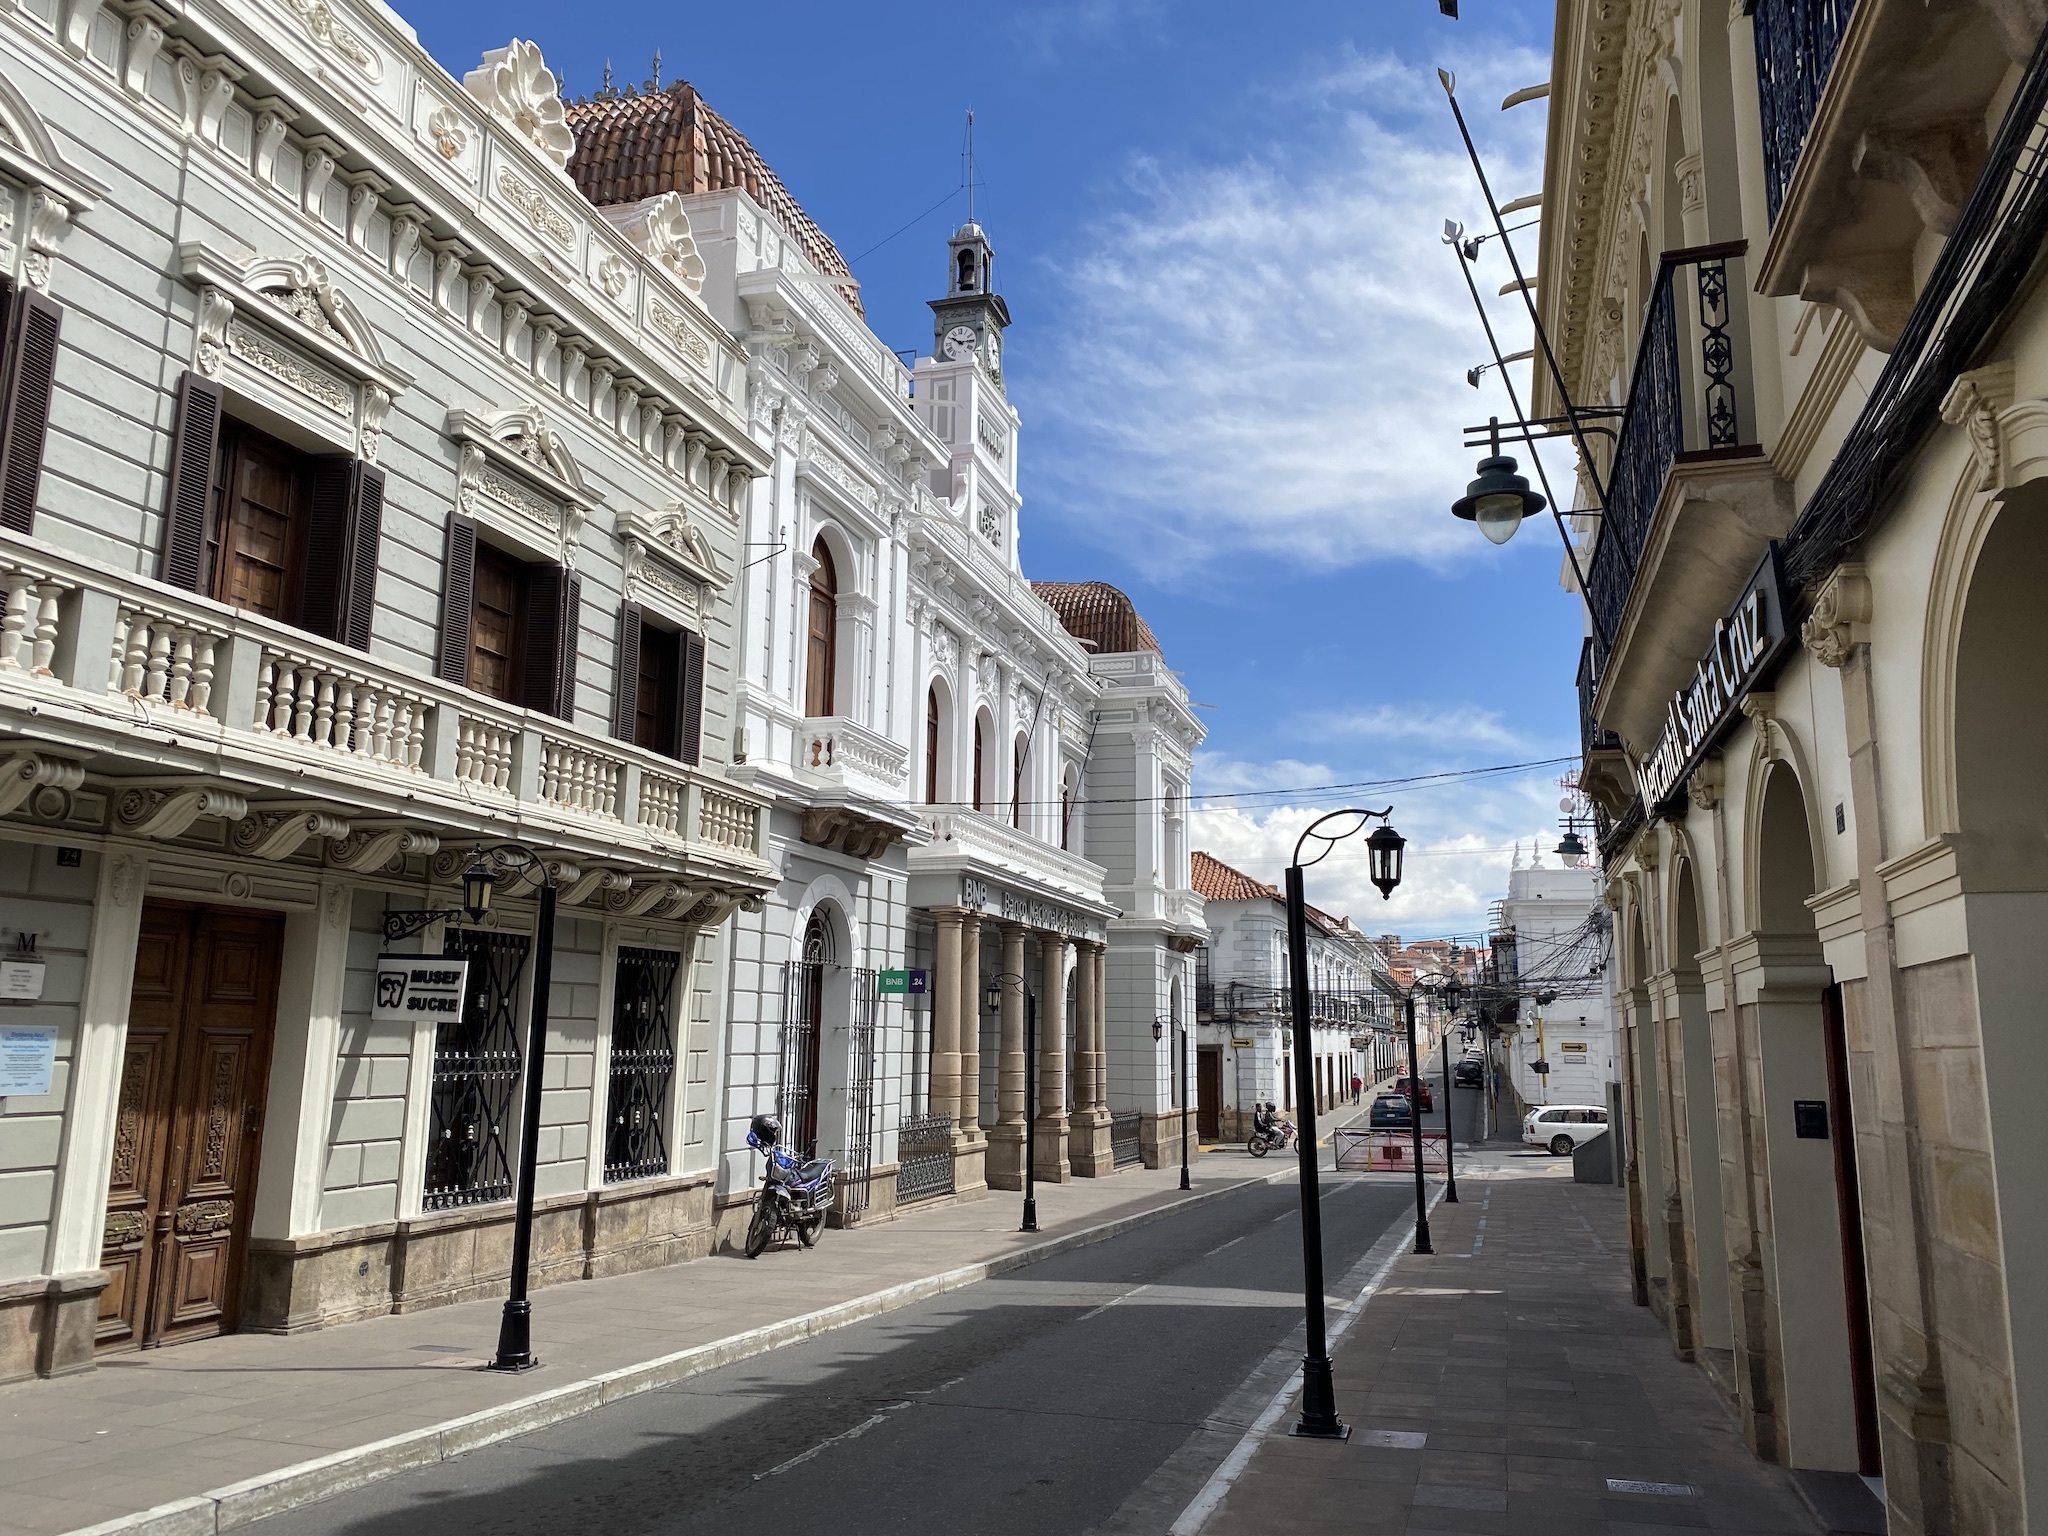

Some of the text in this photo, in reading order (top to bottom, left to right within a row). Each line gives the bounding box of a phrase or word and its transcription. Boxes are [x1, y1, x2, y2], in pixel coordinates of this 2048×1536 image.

[1637, 590, 1764, 819] Mercantil Santa Cruz
[964, 878, 987, 906] BNB
[1004, 892, 1027, 916] Banco
[17, 931, 38, 952] M
[410, 970, 461, 985] MUSEF
[885, 978, 903, 986] BNB
[407, 997, 458, 1012] SUCRE
